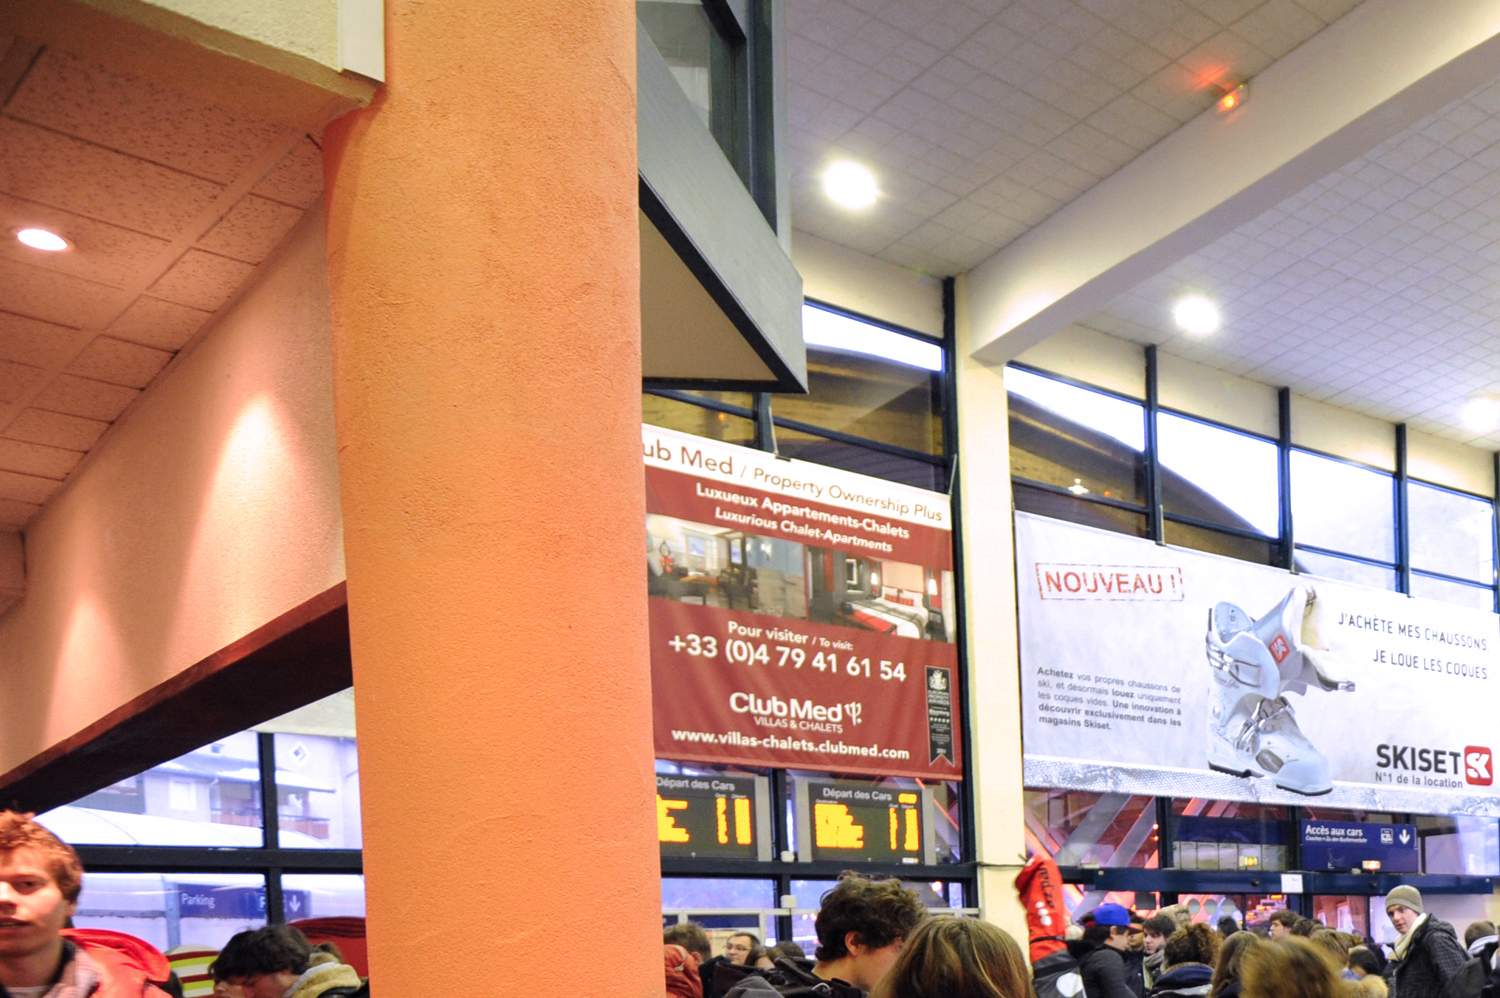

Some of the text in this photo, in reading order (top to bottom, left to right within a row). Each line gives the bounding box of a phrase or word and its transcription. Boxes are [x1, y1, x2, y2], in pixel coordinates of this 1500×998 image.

[642, 439, 672, 461] ub
[680, 446, 733, 475] Med
[753, 467, 824, 498] Property
[828, 484, 910, 516] Ownership
[914, 503, 943, 522] Plus
[695, 481, 910, 539] Luxueux Appartements-Chalets
[714, 506, 893, 553] Luxurious Chalet-Apartments
[1045, 571, 1163, 594] NOUVEAU
[727, 620, 763, 638] Pour
[765, 627, 809, 645] visiter
[819, 637, 831, 648] To
[1338, 612, 1393, 634] J'ACHÈTE
[1398, 623, 1421, 639] MES
[668, 633, 907, 682] +33 (0)4 79 41 61 54
[1373, 649, 1488, 680] JE LOUE LES COQUES
[1037, 666, 1181, 694] Achetez vos propres chaussons de
[729, 691, 843, 723] Club Med
[1037, 691, 1051, 700] les
[1053, 693, 1084, 706] coques
[1112, 700, 1129, 709] Une
[1131, 702, 1174, 715] innovation
[1176, 707, 1182, 716] à
[1055, 682, 1065, 690] et
[1067, 682, 1109, 696] désormais
[1111, 688, 1134, 699] louez
[1137, 692, 1181, 706] uniquement
[754, 716, 843, 734] VILLAS & CHALETS
[1038, 703, 1182, 727] découvrir exclusivement dans les
[1039, 716, 1112, 731] magasins Skiset.
[671, 729, 910, 760] www.villas-chalets.clubmed.com
[1376, 743, 1461, 775] SKISET
[656, 776, 735, 791] Départ des Cars
[1375, 771, 1463, 788] N°1 de la location
[822, 787, 853, 799] Départ
[854, 790, 870, 799] des
[871, 790, 892, 801] Cars
[1305, 824, 1363, 836] Accès aux cars
[181, 893, 216, 909] Parking
